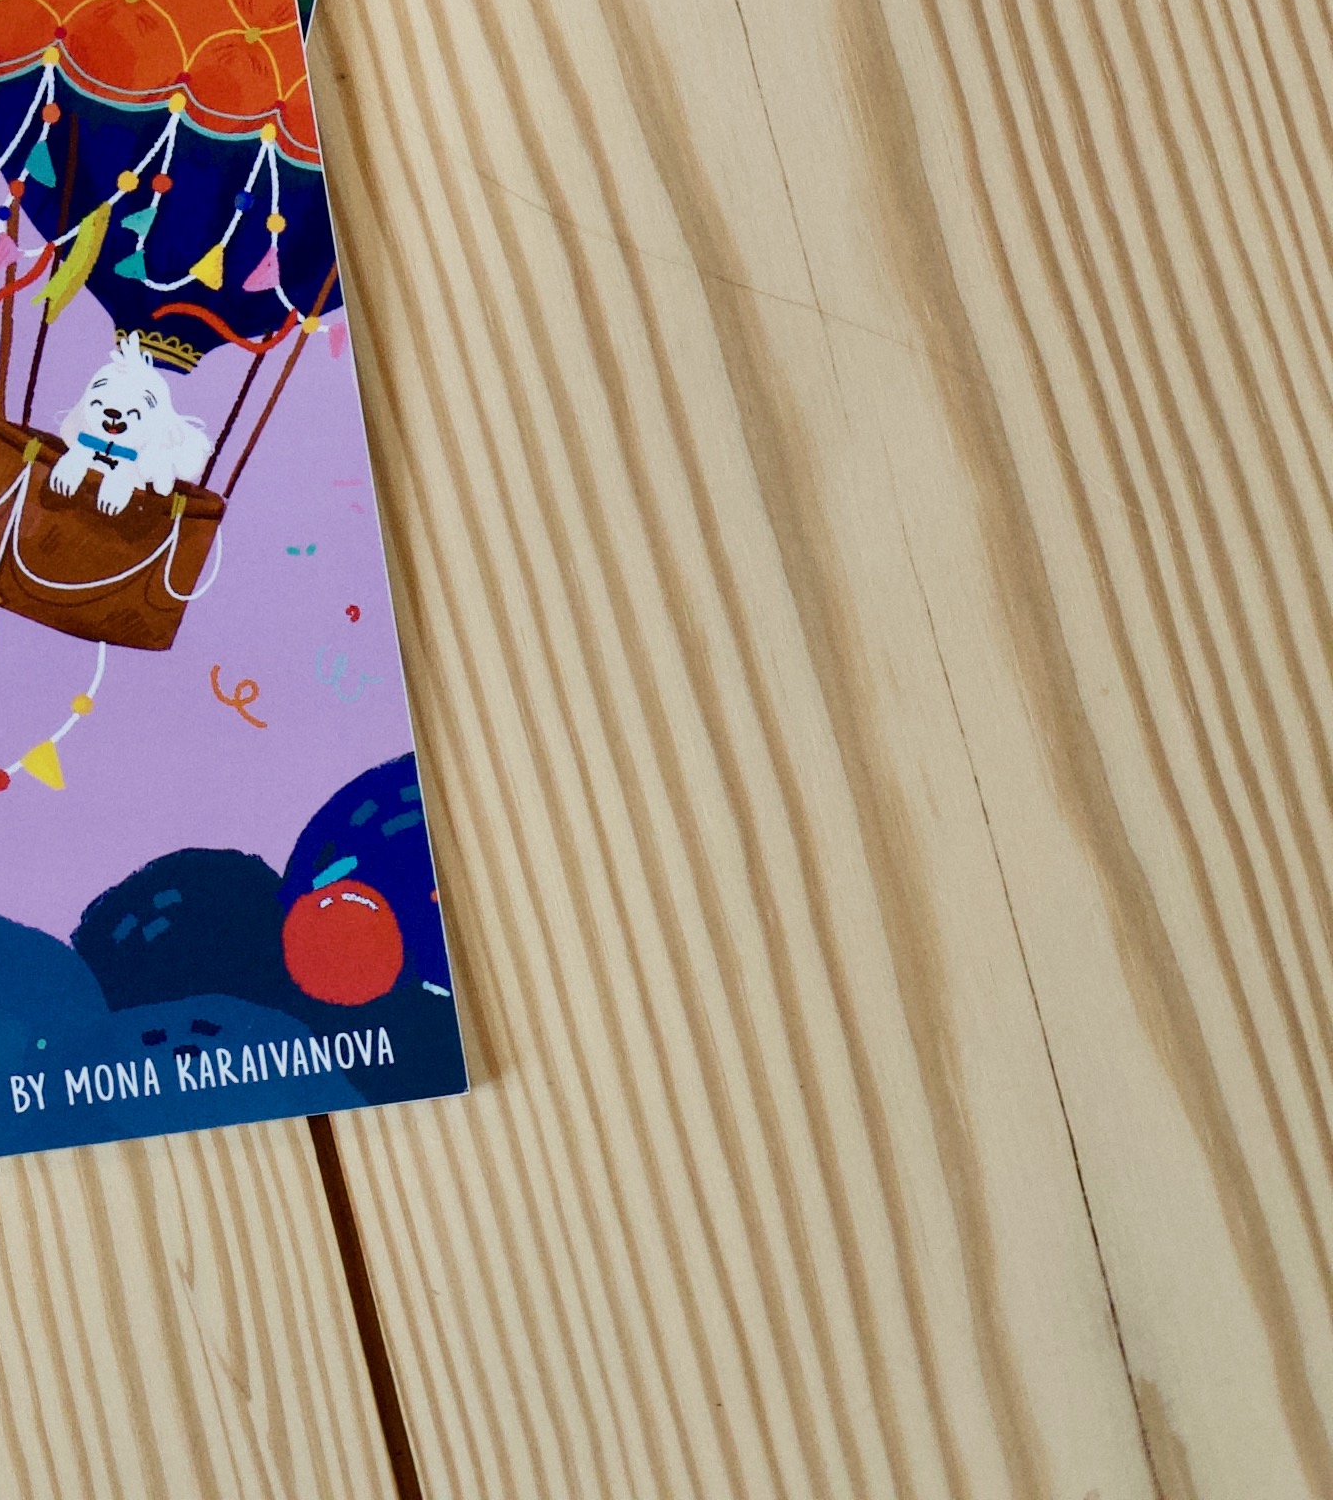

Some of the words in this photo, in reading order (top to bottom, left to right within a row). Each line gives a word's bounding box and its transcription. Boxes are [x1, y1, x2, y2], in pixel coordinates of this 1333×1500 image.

[10, 1073, 45, 1113] BY
[65, 1058, 160, 1105] MONA
[176, 1027, 394, 1091] KARAIVANOVA
